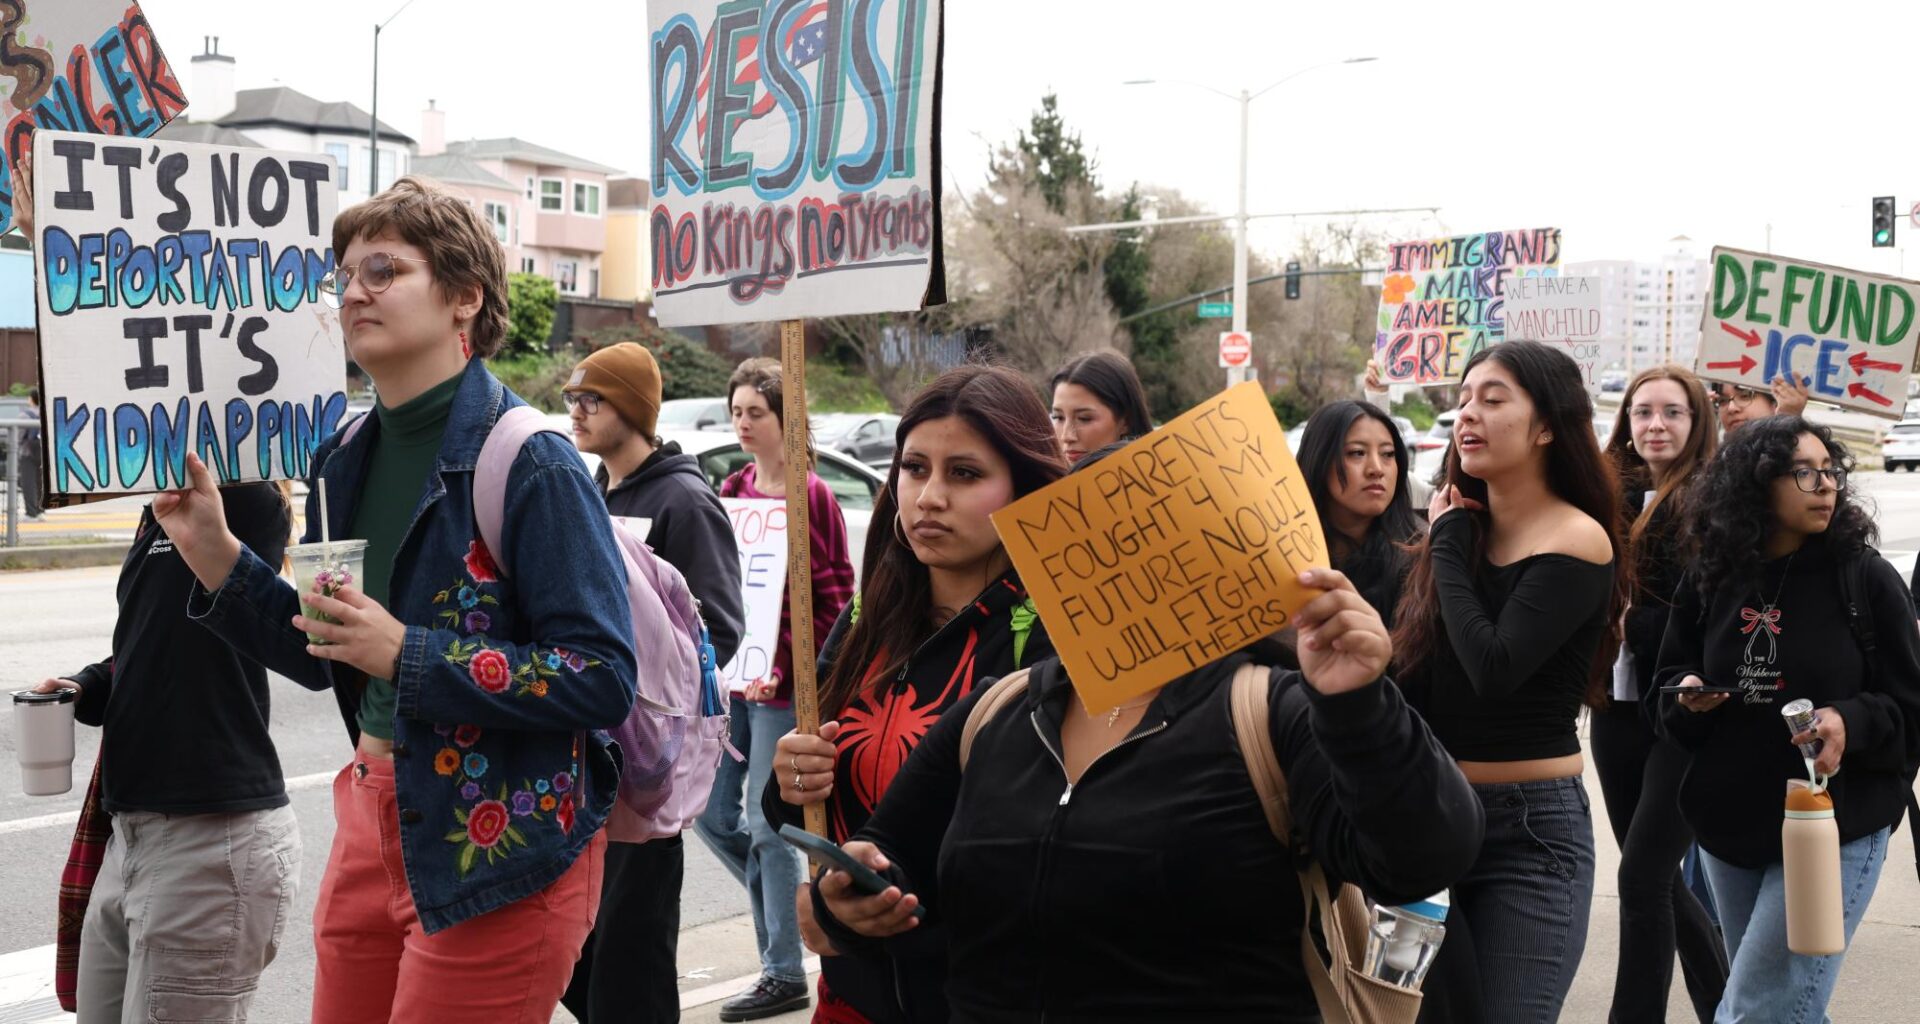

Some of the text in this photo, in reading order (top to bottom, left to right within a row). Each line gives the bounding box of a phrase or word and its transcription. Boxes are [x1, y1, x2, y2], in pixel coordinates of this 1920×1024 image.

[53, 139, 330, 236] IT'S NOT
[42, 225, 335, 315] DEPORTATION
[1388, 228, 1562, 272] IMMIGRANTS
[1423, 268, 1512, 300] MAKE
[1505, 277, 1590, 300] WE HAVE A
[1713, 253, 1916, 346] DEFUND
[1393, 299, 1504, 331] AMERIC
[1506, 307, 1600, 341] MANCHILD
[123, 313, 279, 395] IT'S
[1384, 328, 1504, 382] GREA
[1573, 344, 1600, 359] OUR
[1762, 329, 1849, 397] ICE
[1017, 400, 1249, 552] MY PARENTS
[729, 507, 787, 544] TOP
[1040, 435, 1273, 593] FOUGHT 4 MY
[1061, 541, 1212, 636] FUTURE
[1086, 522, 1320, 681] WILL FIGHT FOR
[1172, 598, 1287, 668] THEIRS
[1736, 664, 1781, 678] Wishbone
[1738, 679, 1778, 695] Pajama
